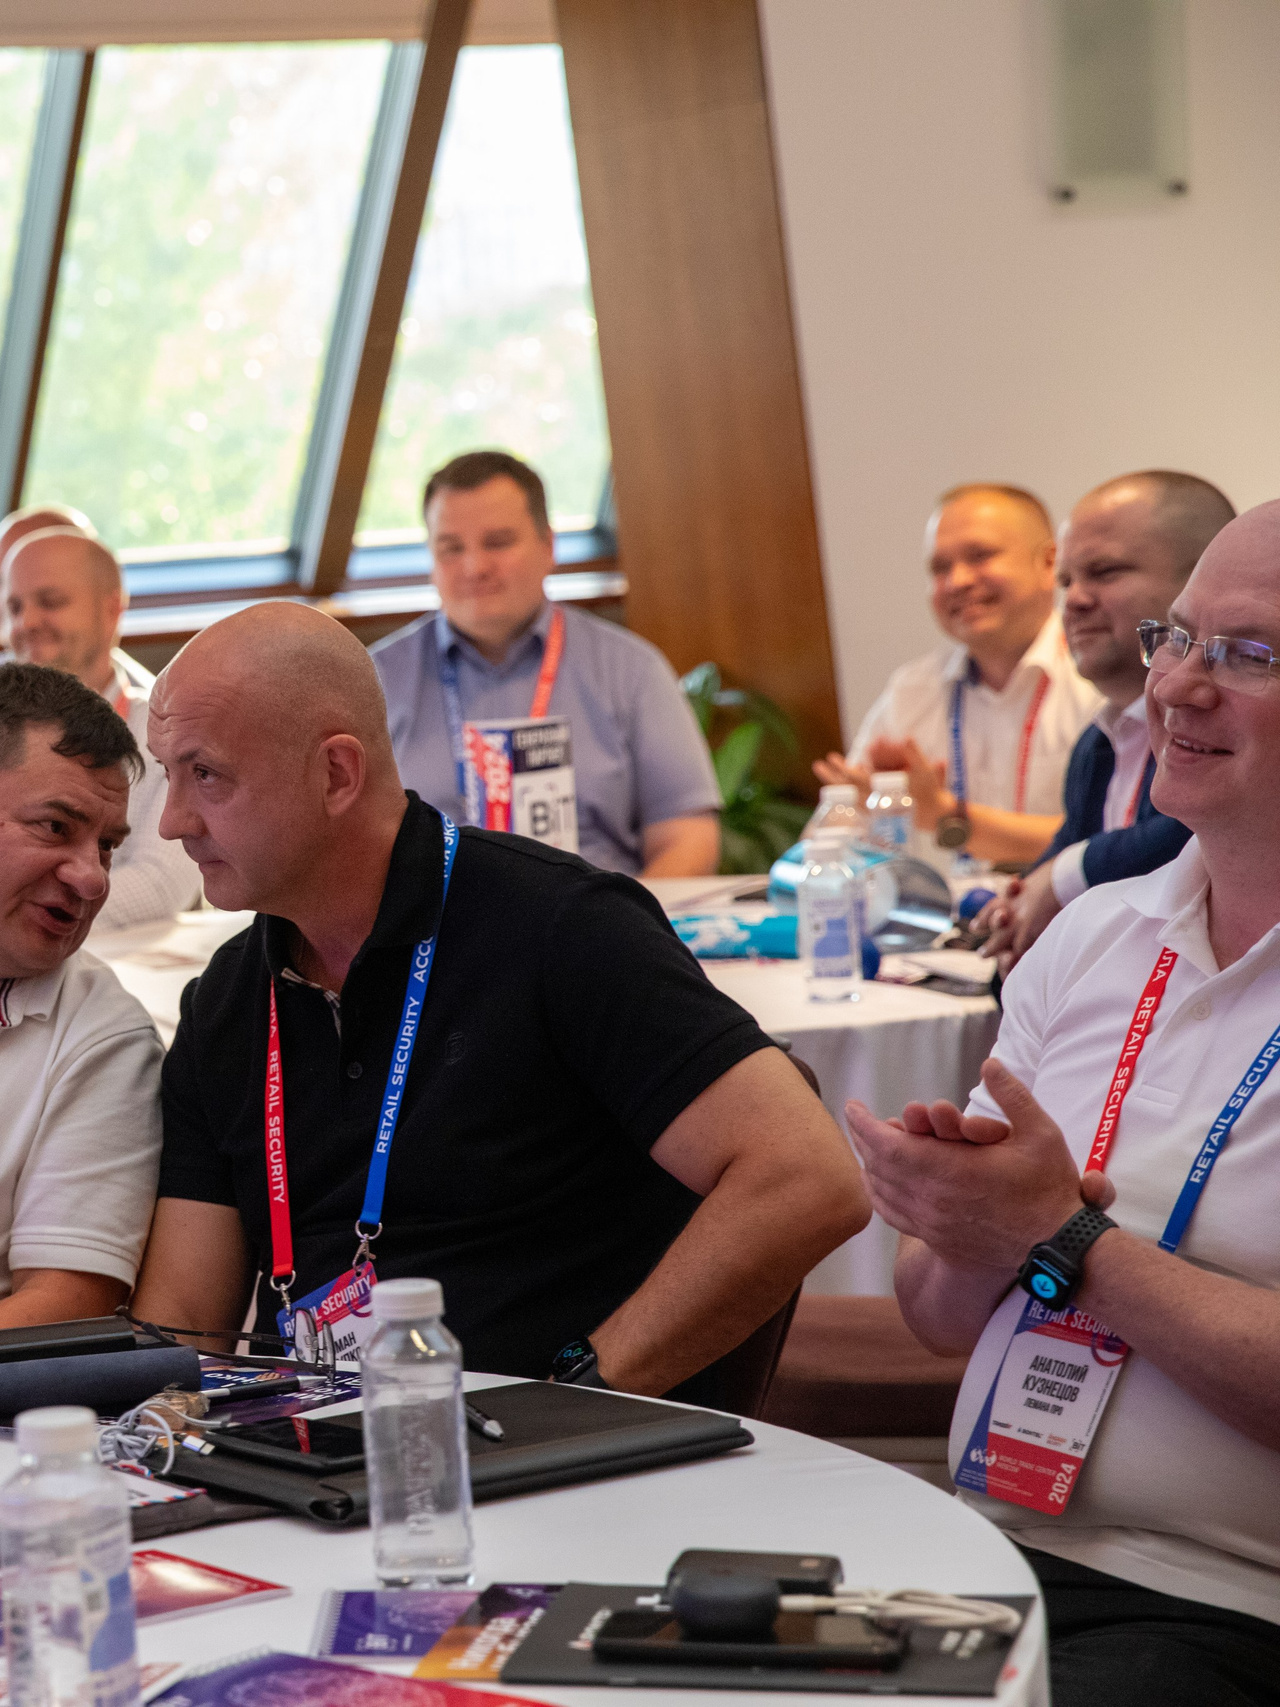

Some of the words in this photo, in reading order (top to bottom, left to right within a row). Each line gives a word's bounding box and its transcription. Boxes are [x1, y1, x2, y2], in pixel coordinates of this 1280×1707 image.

[1122, 996, 1156, 1062] RETAIL
[269, 1050, 280, 1113] RETAIL
[376, 1090, 401, 1154] RETAIL
[392, 996, 420, 1086] SECURITY
[1189, 1113, 1234, 1183] RETAIL
[1228, 1029, 1280, 1109] SECURI
[1092, 1067, 1130, 1161] SECURITY
[269, 1115, 285, 1203] SECURITY
[321, 1275, 372, 1315] SECURITY
[1022, 1374, 1080, 1403] КУЗНЕЦОВ
[1029, 1355, 1088, 1384] АНАТОЛИЙ
[1048, 1462, 1076, 1504] 2024
